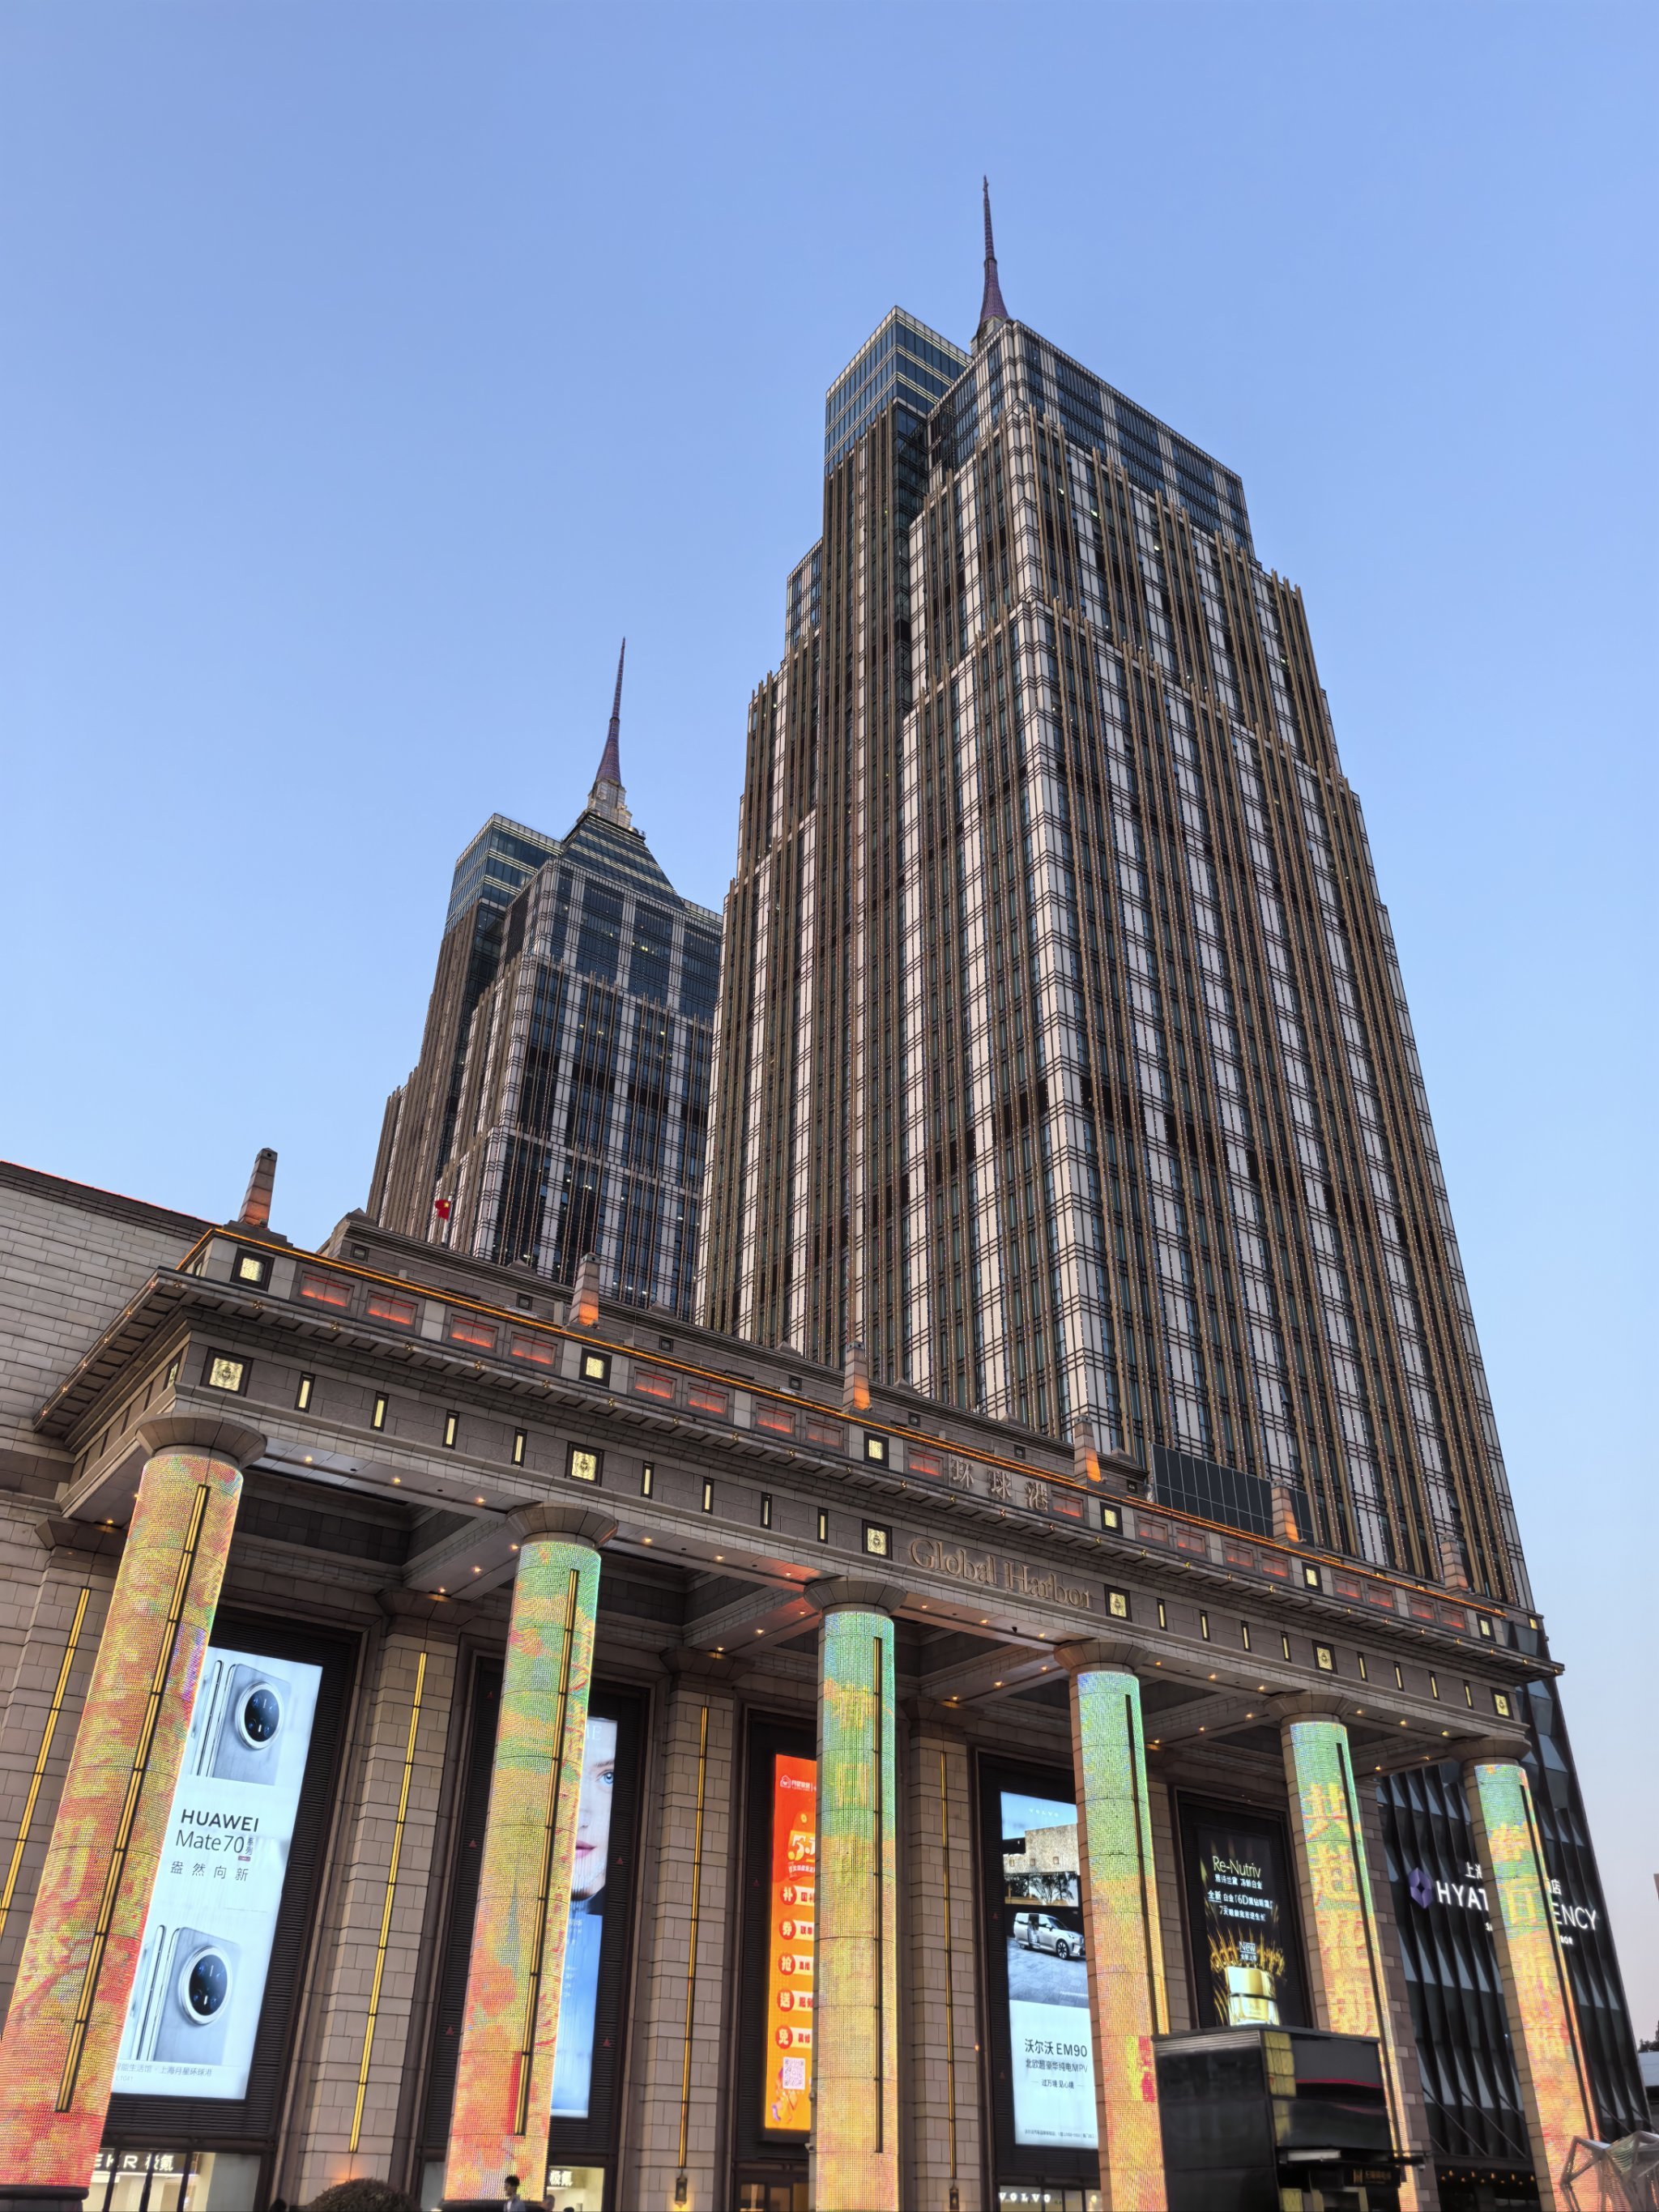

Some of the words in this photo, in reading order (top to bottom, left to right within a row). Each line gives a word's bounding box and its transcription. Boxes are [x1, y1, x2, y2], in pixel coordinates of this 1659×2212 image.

[952, 1458, 1048, 1512] 环球港
[911, 1539, 998, 1587] Global
[1005, 1561, 1092, 1610] Harbor
[181, 1809, 259, 1832] HUAWEI
[1029, 1808, 1059, 1818] VOLVO
[245, 1837, 254, 1856] 系列
[170, 1860, 249, 1882] 盎然向新
[1212, 1856, 1261, 1878] Re-Nutriv
[1239, 1941, 1256, 1953] New
[780, 1992, 791, 2008] 送
[778, 2028, 789, 2045] 免
[1025, 2038, 1054, 2056] 沃尔沃
[1056, 2043, 1087, 2057] EM90
[999, 2192, 1051, 2203] VOLVO
